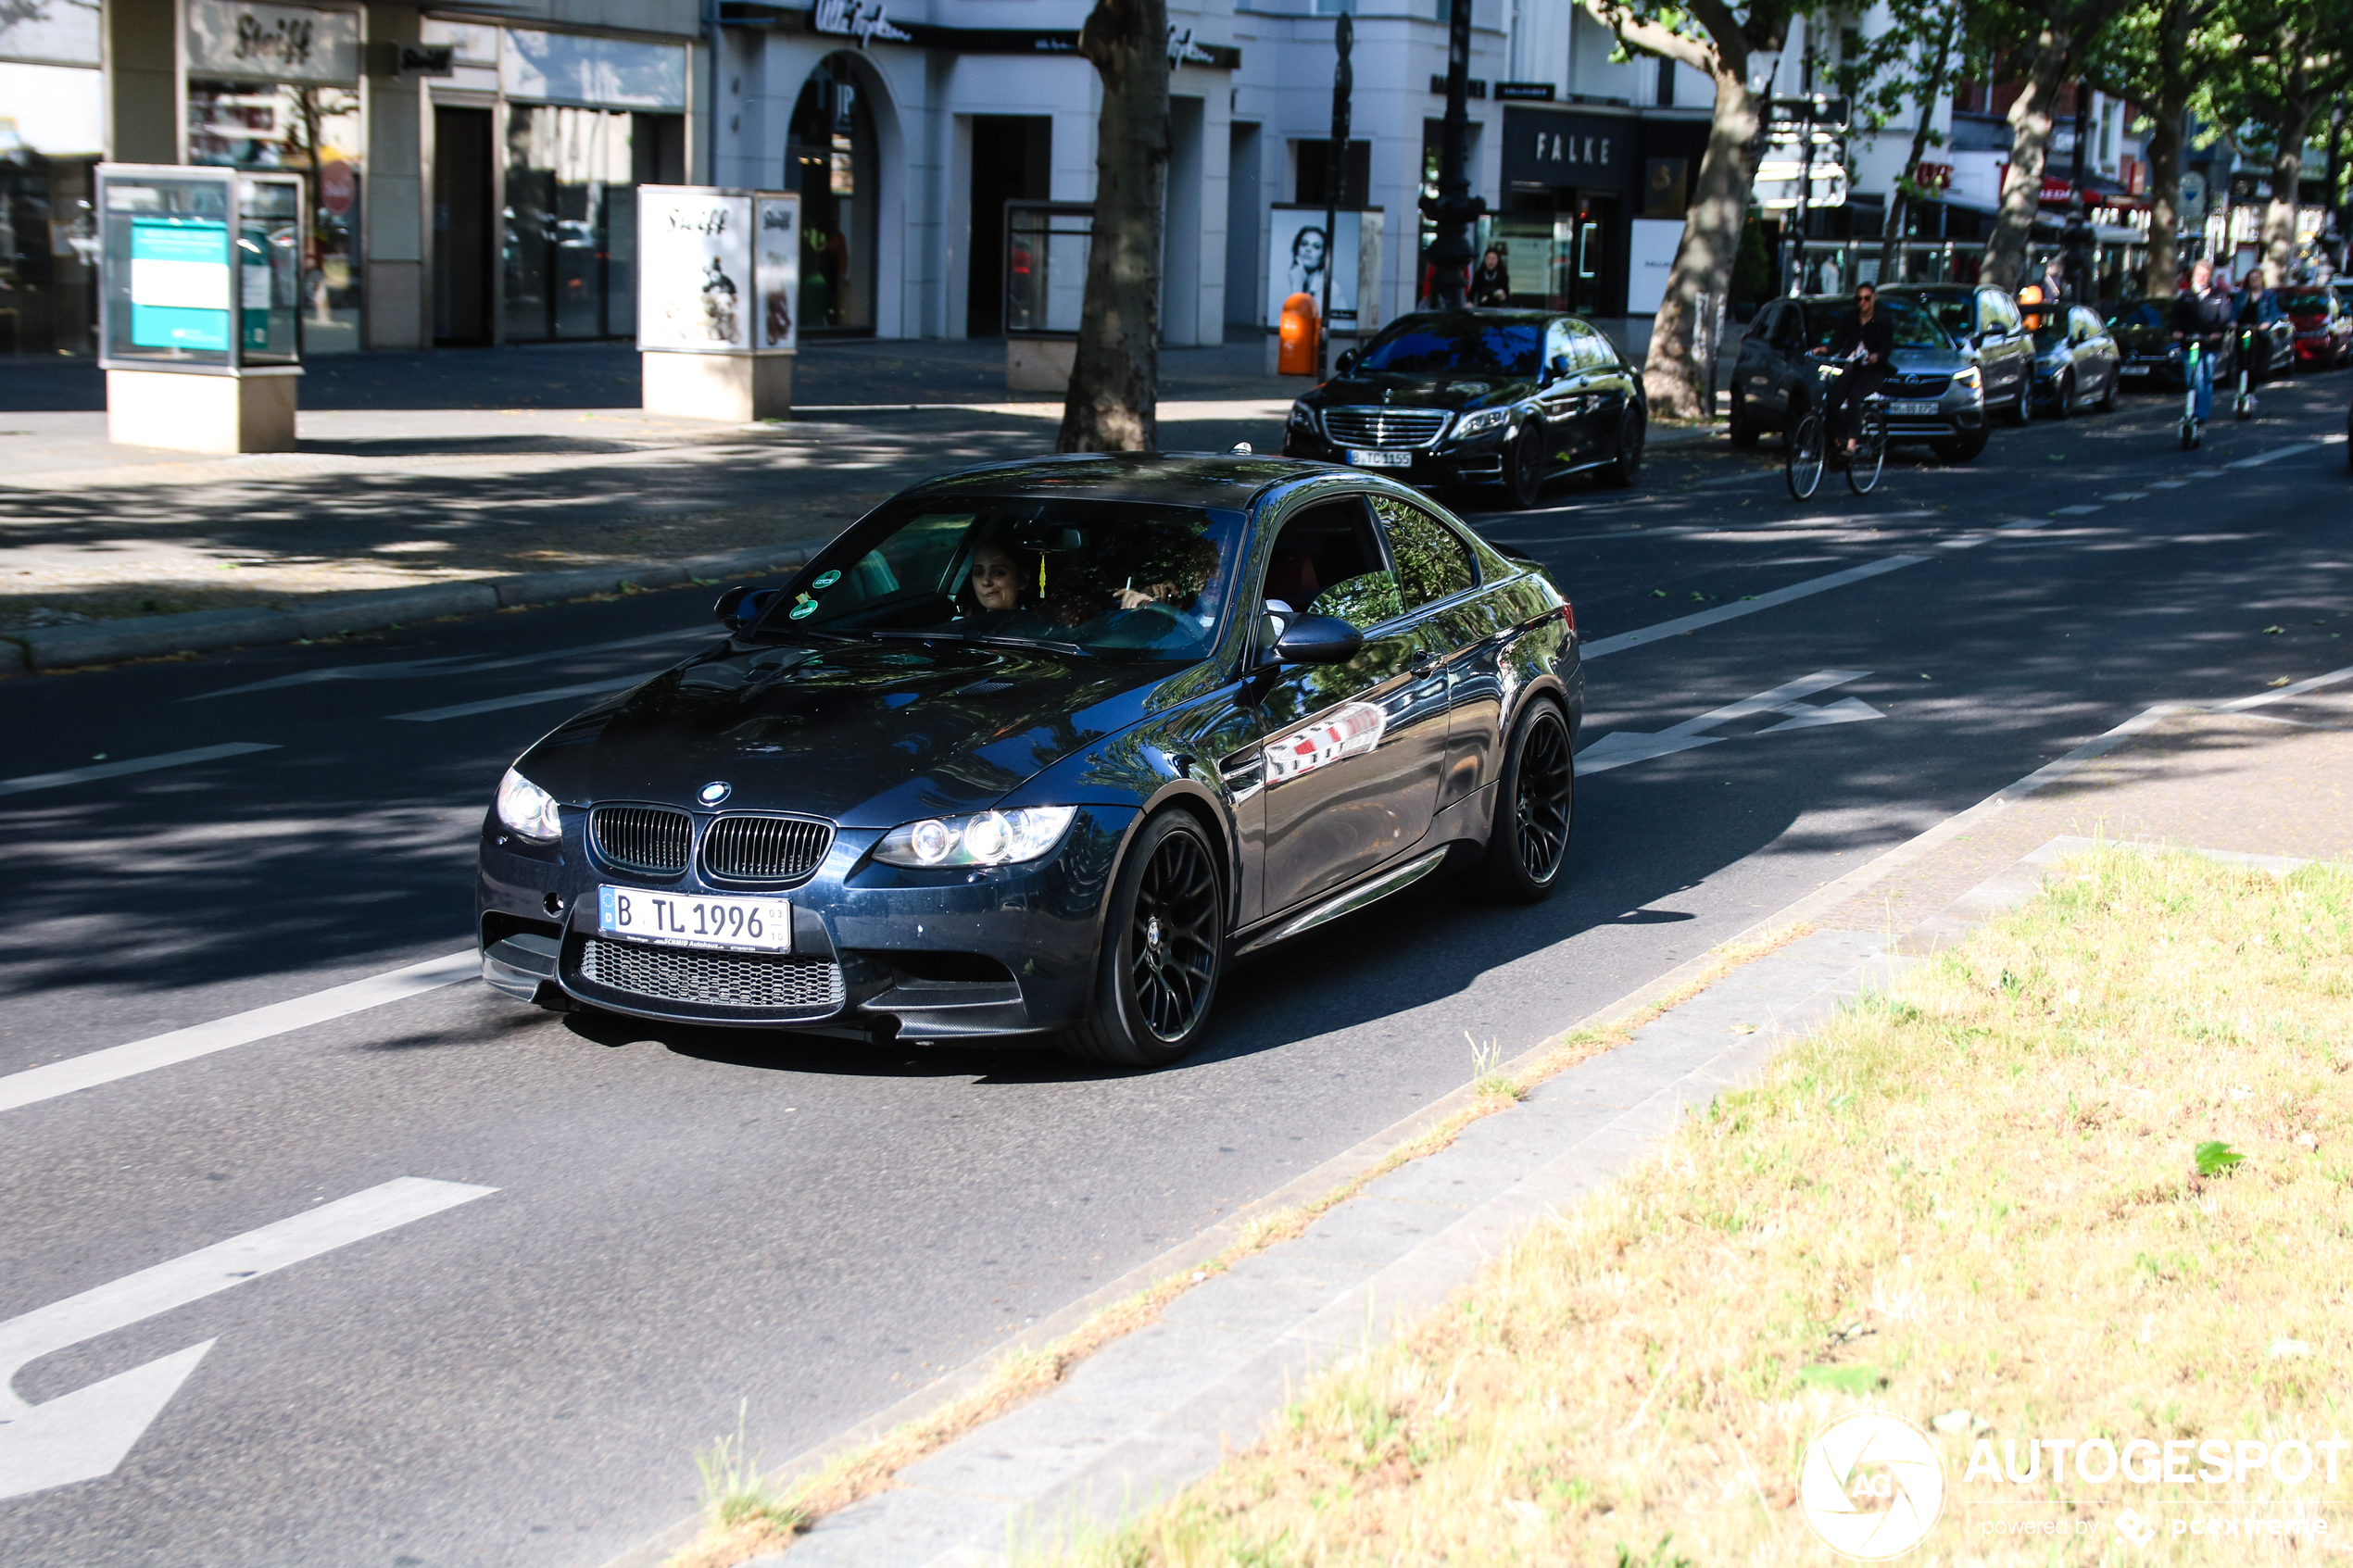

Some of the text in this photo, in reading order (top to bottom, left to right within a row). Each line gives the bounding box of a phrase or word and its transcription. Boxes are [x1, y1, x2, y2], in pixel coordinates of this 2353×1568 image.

[234, 13, 313, 65] Steiff
[1536, 132, 1610, 165] FALKE
[667, 208, 729, 236] Steiff
[1353, 452, 1359, 462] B
[618, 895, 763, 938] B TL 1996
